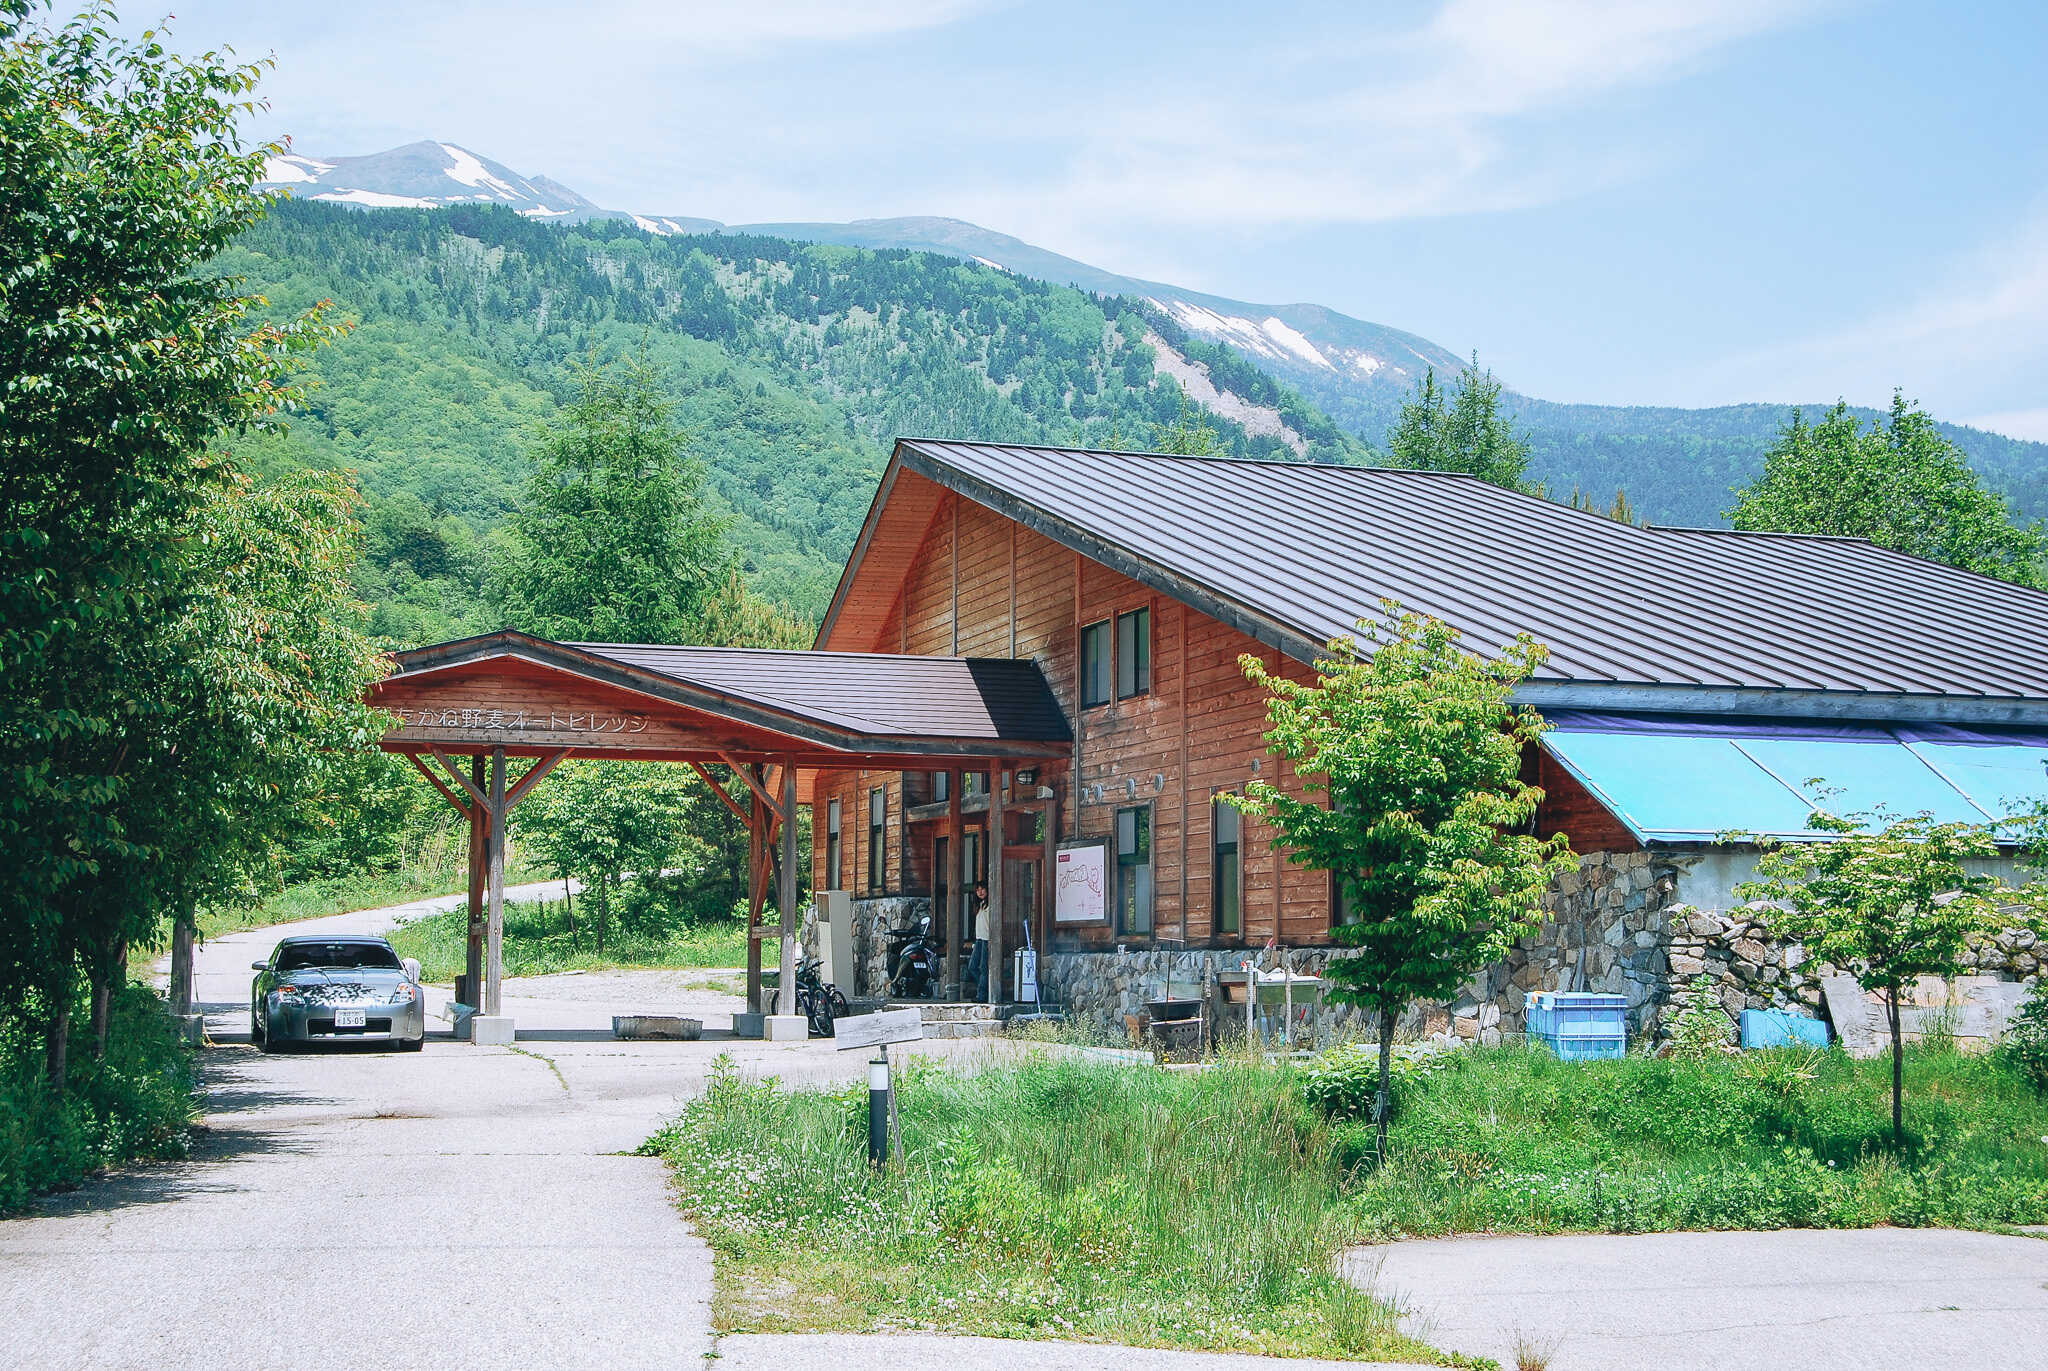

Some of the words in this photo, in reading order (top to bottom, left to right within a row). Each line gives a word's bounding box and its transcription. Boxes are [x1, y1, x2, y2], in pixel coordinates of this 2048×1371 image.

[373, 706, 649, 733] たかね野麦オートビレッジ
